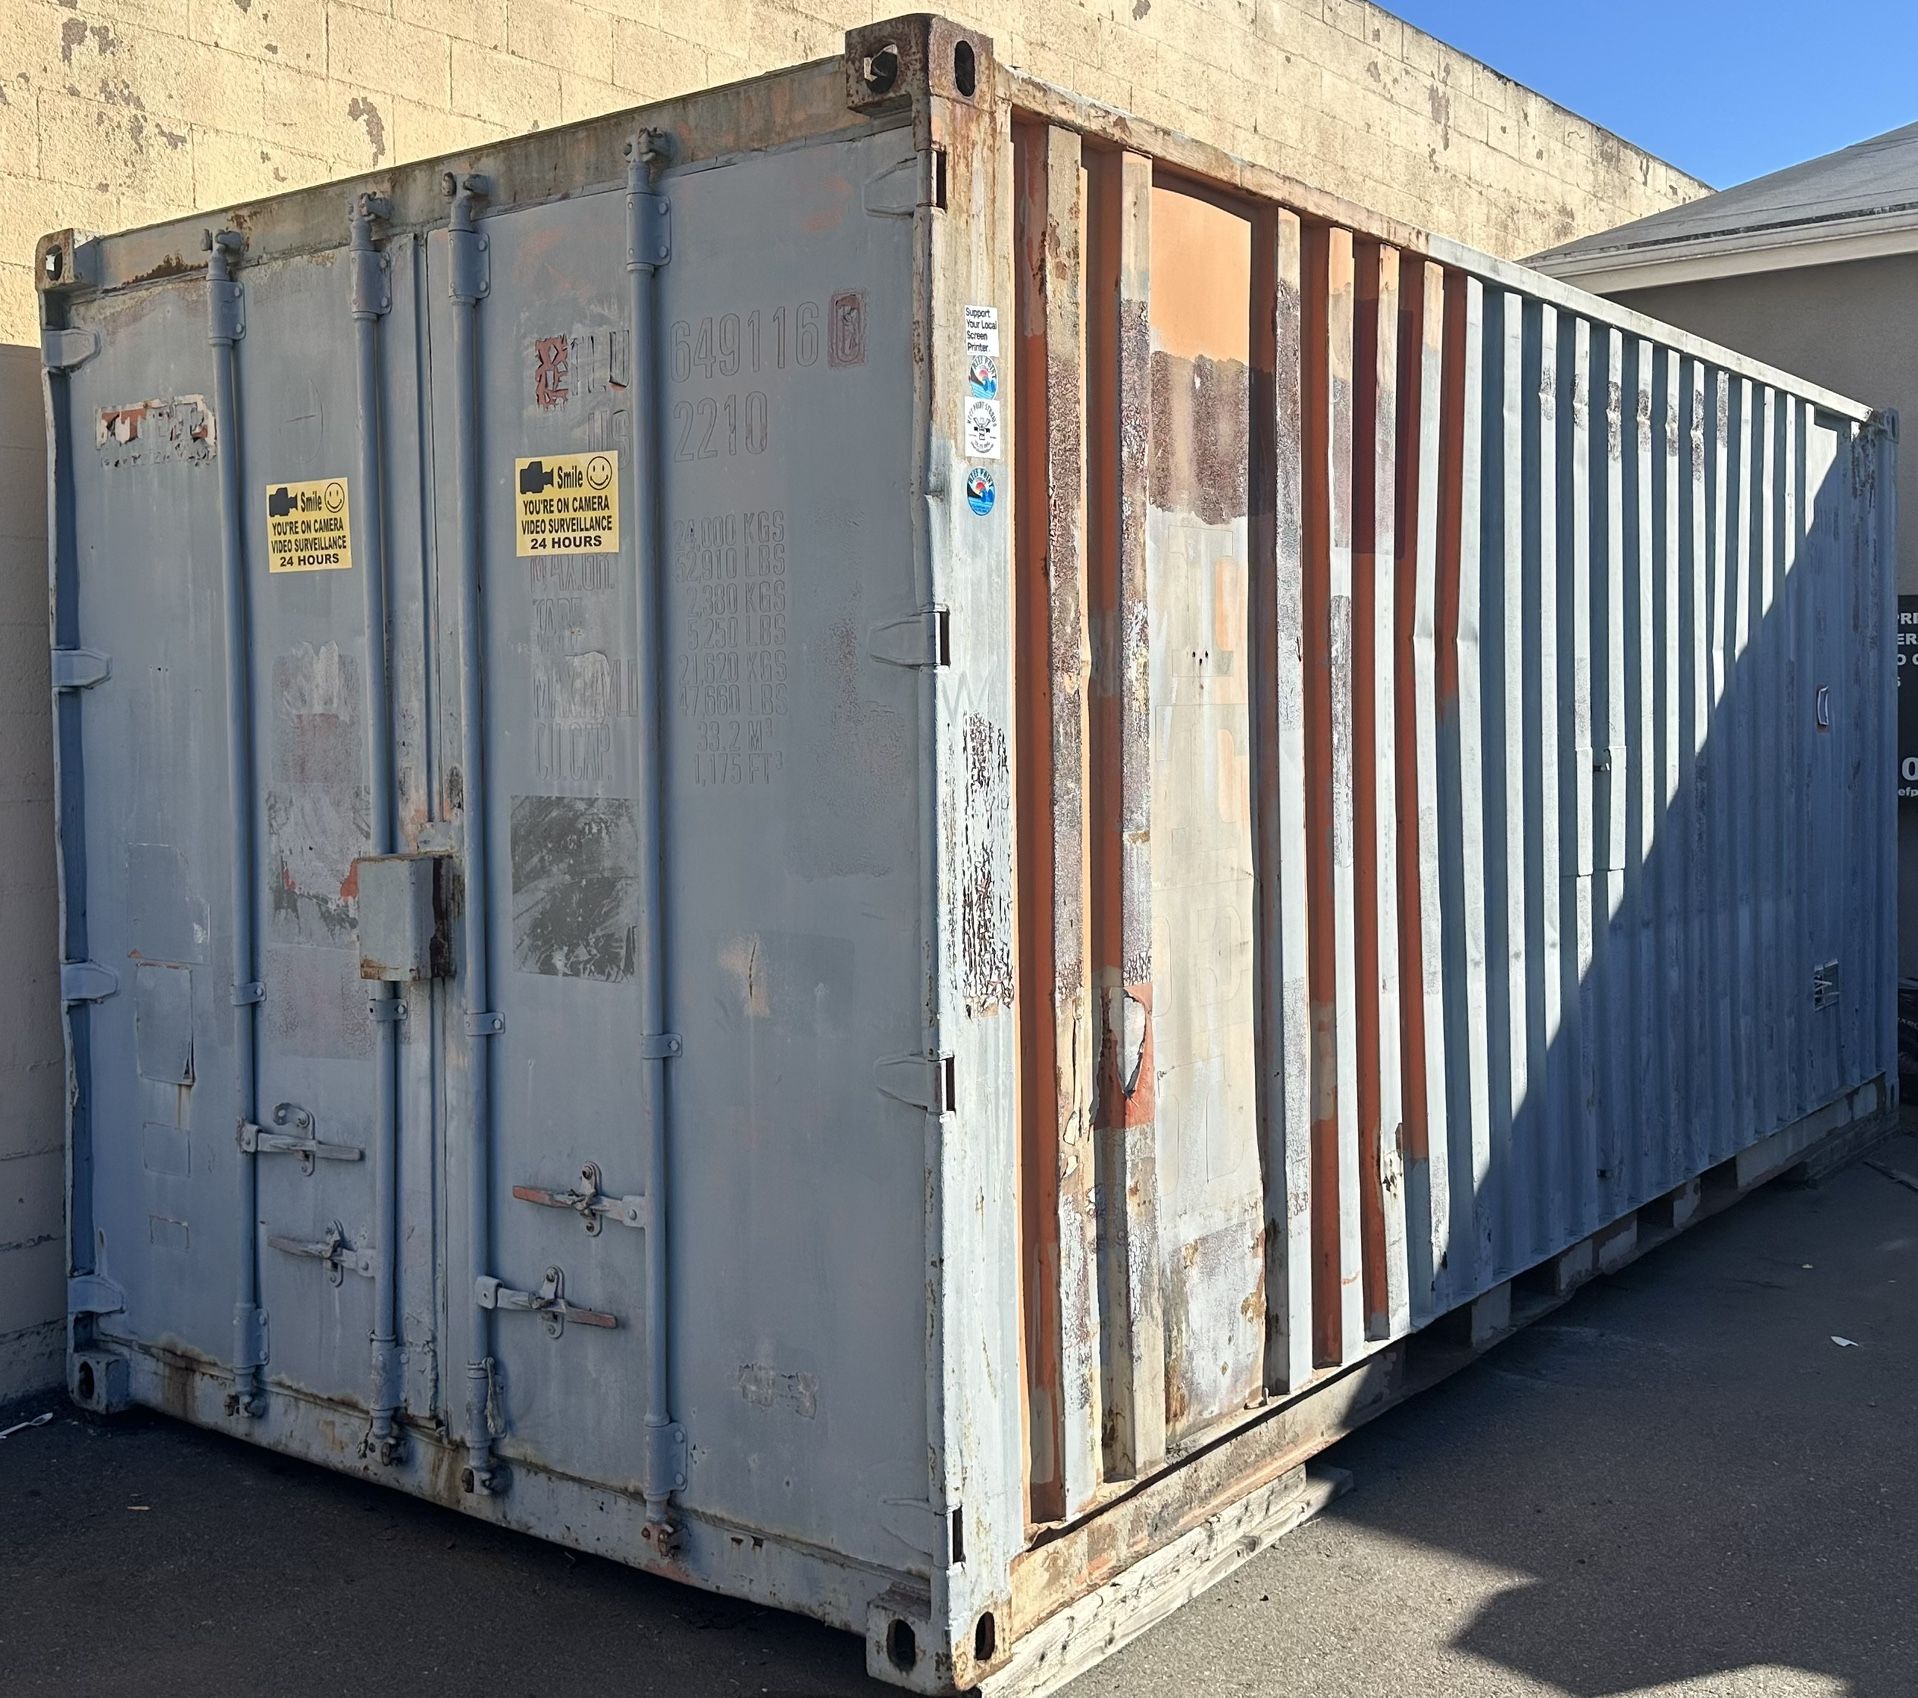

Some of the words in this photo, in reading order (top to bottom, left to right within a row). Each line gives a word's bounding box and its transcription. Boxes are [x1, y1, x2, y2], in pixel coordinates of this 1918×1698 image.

[966, 307, 990, 318] Support
[967, 319, 980, 328] Your
[981, 320, 998, 330] Local
[670, 301, 819, 383] 649116
[967, 330, 988, 340] Screen
[673, 391, 767, 463] 2210
[557, 466, 583, 489] Smile
[300, 491, 322, 512] Smile
[523, 499, 554, 515] YOU'RE
[556, 497, 569, 513] ON
[572, 495, 610, 512] CAMERA
[272, 521, 299, 536] YOU'RE
[301, 520, 312, 534] ON
[313, 517, 344, 533] CAMERA
[521, 519, 546, 535] VIDEO
[548, 515, 613, 533] SURVEILLANCE
[744, 510, 785, 544] KGS
[271, 539, 292, 554] VIDEO
[294, 535, 347, 552] SURVEILLANCE
[530, 538, 547, 549] 24
[551, 535, 602, 548] HOURS
[280, 556, 294, 567] 24
[298, 553, 339, 566] HOURS
[744, 544, 786, 577] LBS
[745, 580, 786, 613] KGS
[746, 613, 786, 647] LBS
[746, 649, 787, 683] KGS
